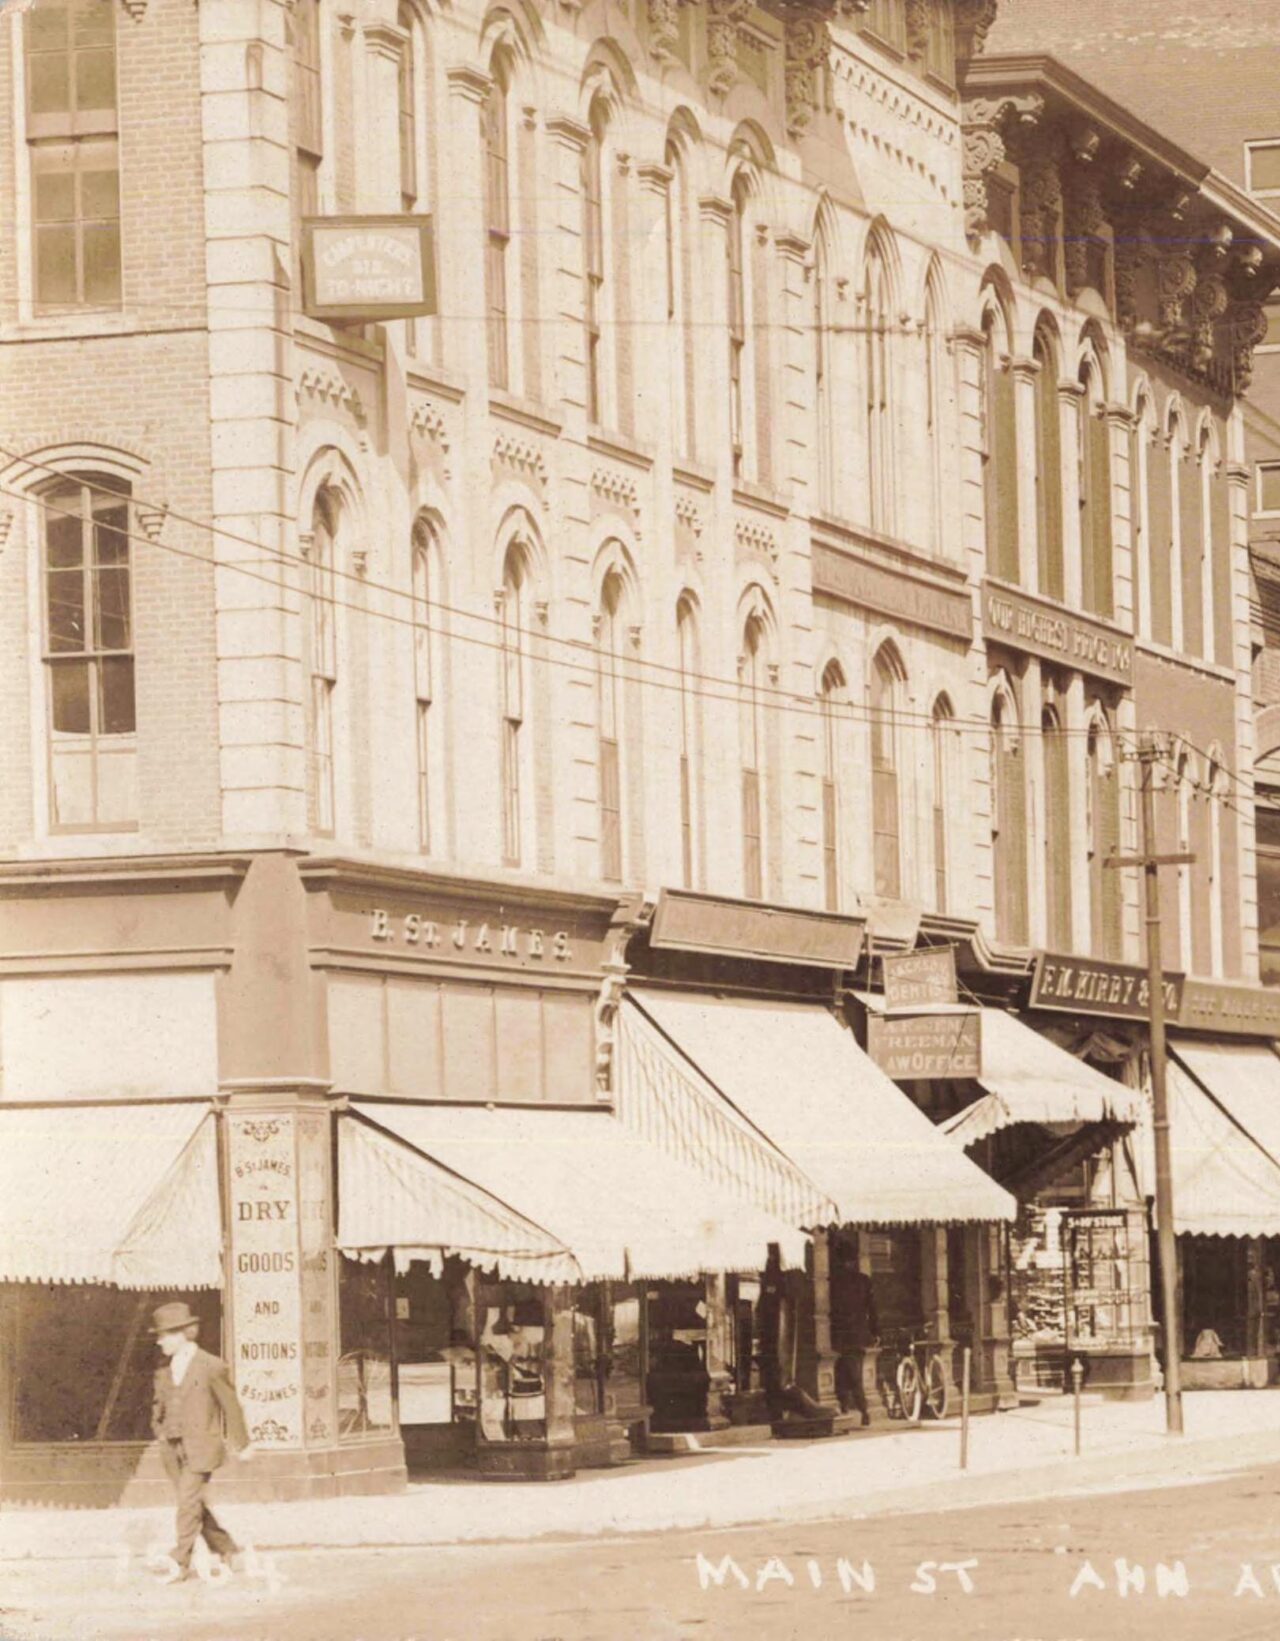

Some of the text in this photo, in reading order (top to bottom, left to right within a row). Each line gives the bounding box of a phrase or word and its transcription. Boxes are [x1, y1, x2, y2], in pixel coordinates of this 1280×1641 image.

[1074, 970, 1136, 1005] KIRBY
[1138, 978, 1150, 1008] &
[237, 1200, 291, 1221] DRY
[238, 1251, 295, 1273] GOODS
[255, 1300, 280, 1315] AND
[241, 1342, 297, 1361] NOTIONS
